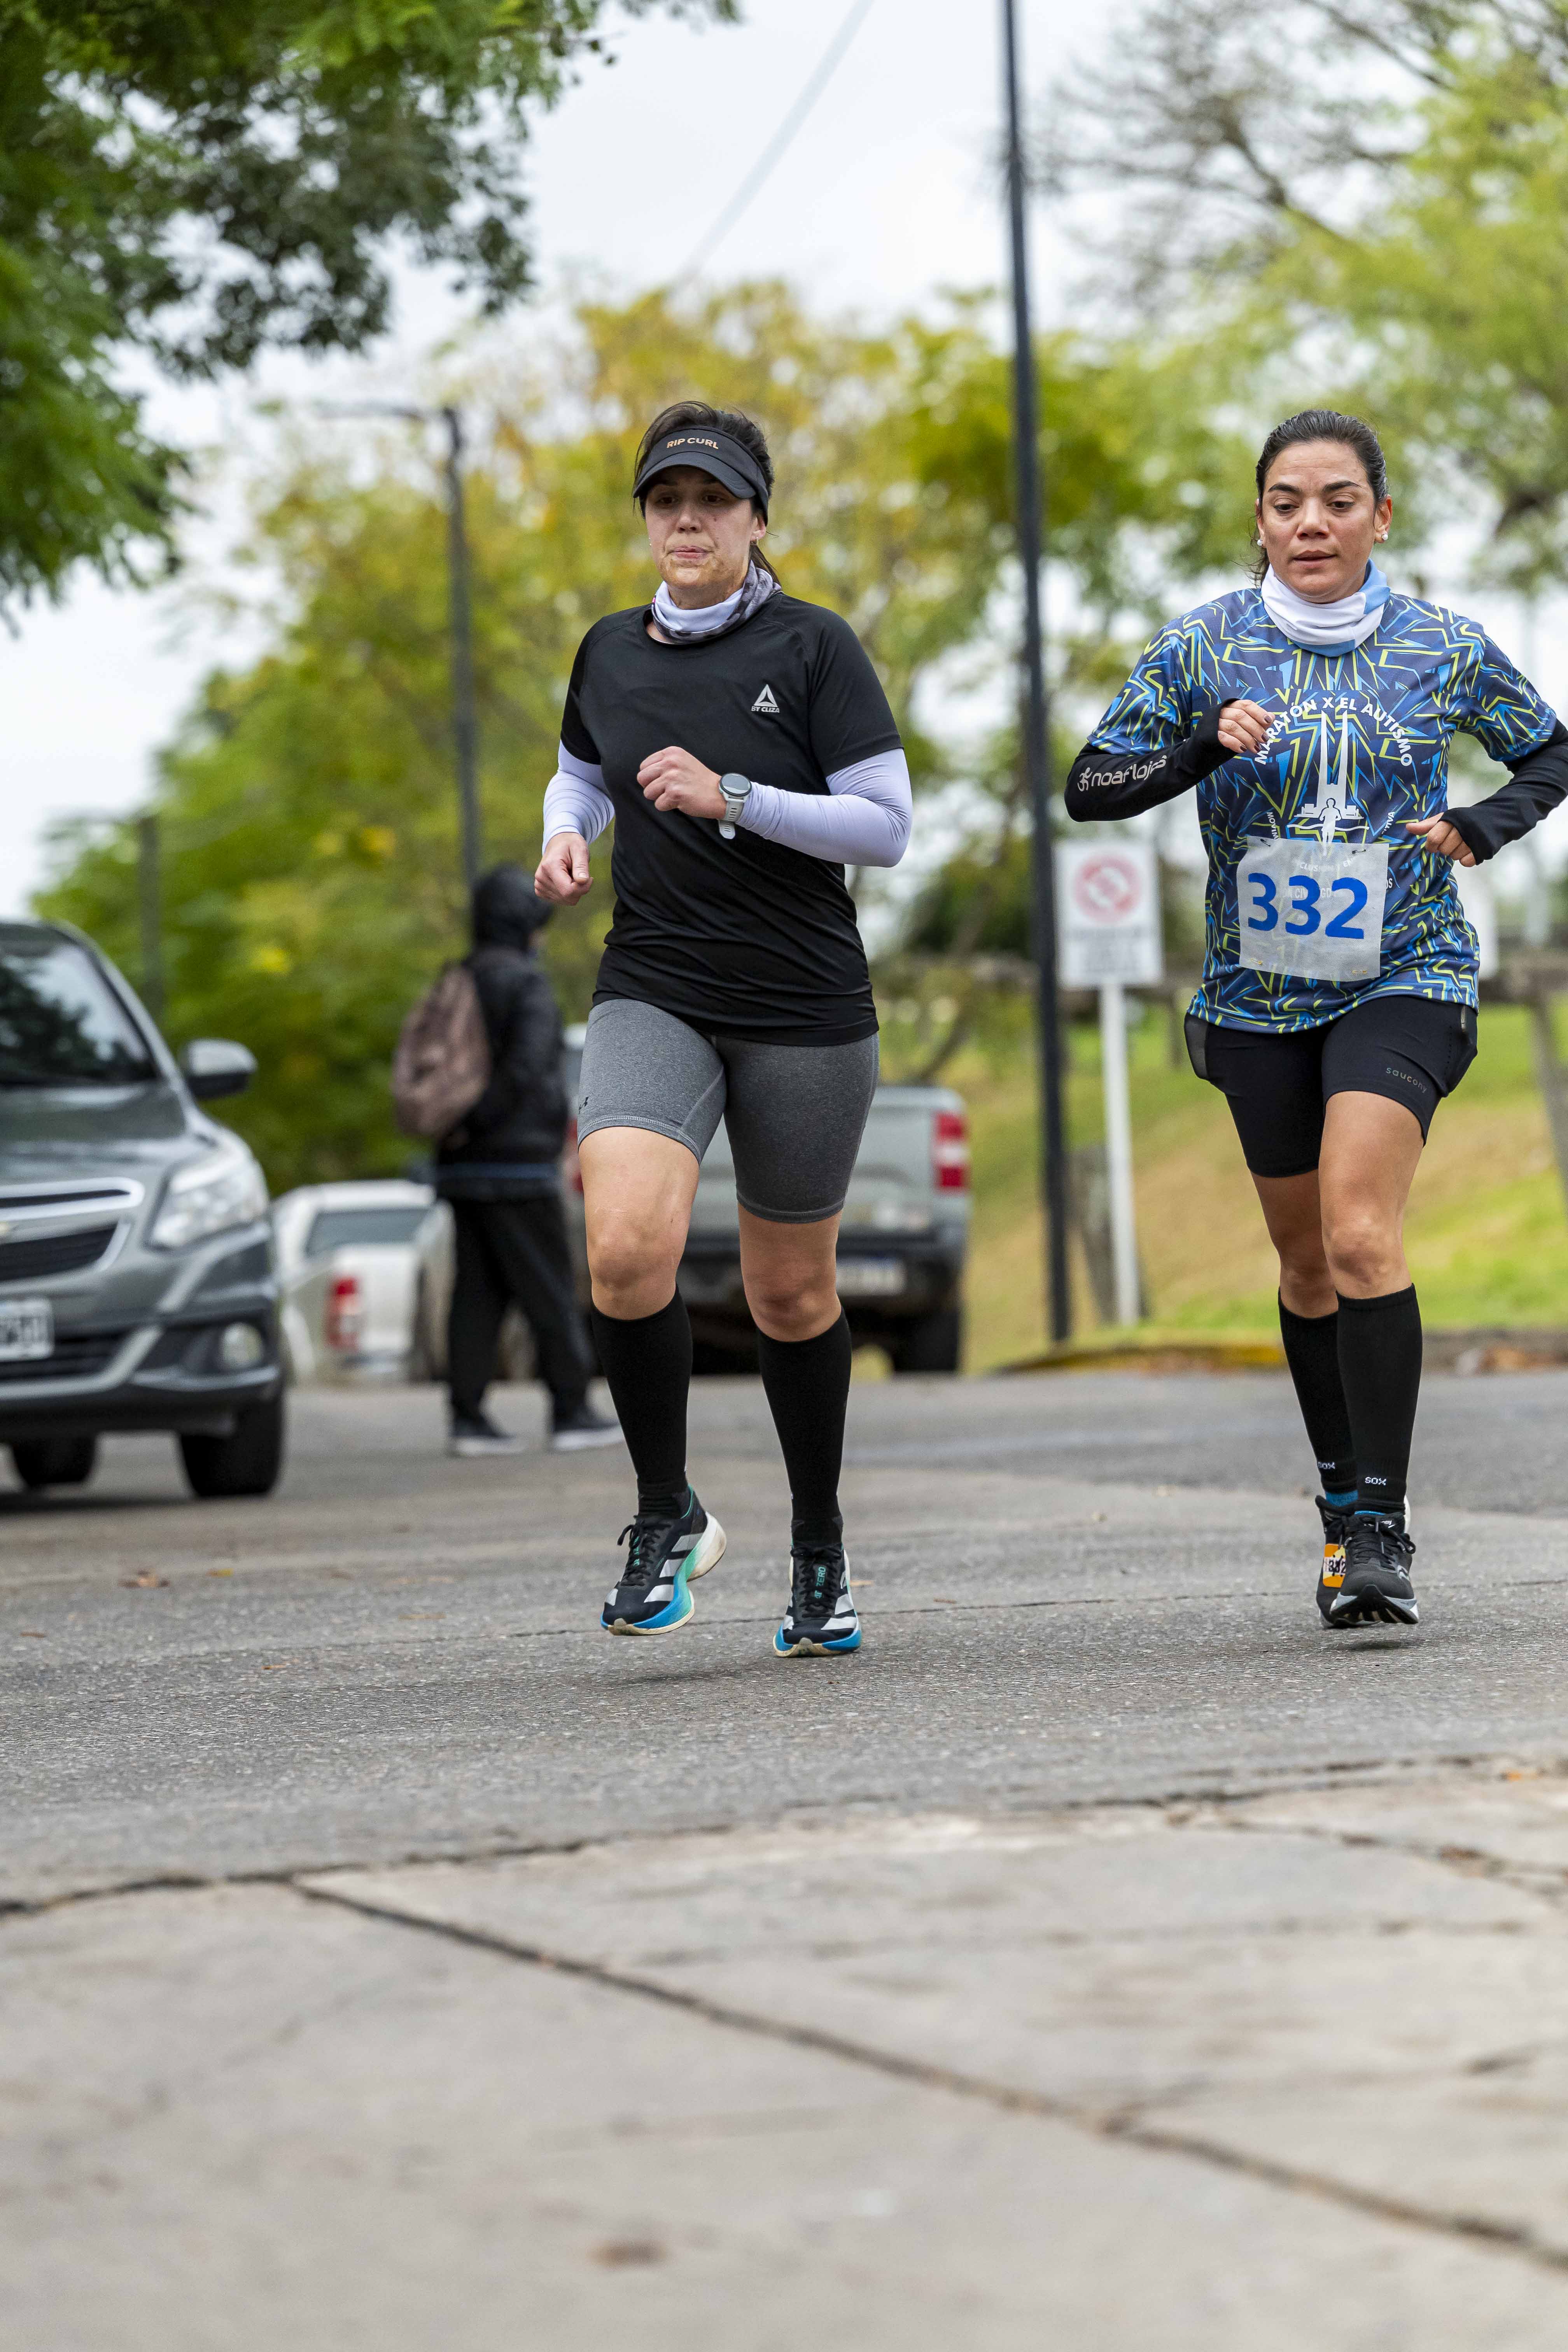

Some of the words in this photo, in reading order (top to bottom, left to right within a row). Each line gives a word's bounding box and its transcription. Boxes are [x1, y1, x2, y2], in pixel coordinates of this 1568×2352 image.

[666, 438, 685, 448] RIP
[687, 437, 719, 449] CURL
[1322, 697, 1334, 709] X
[1340, 697, 1357, 711] EL
[1360, 703, 1412, 766] AUTISMO
[1247, 872, 1368, 940] 332
[1385, 1067, 1427, 1093] saucony
[1365, 1477, 1387, 1486] SOX
